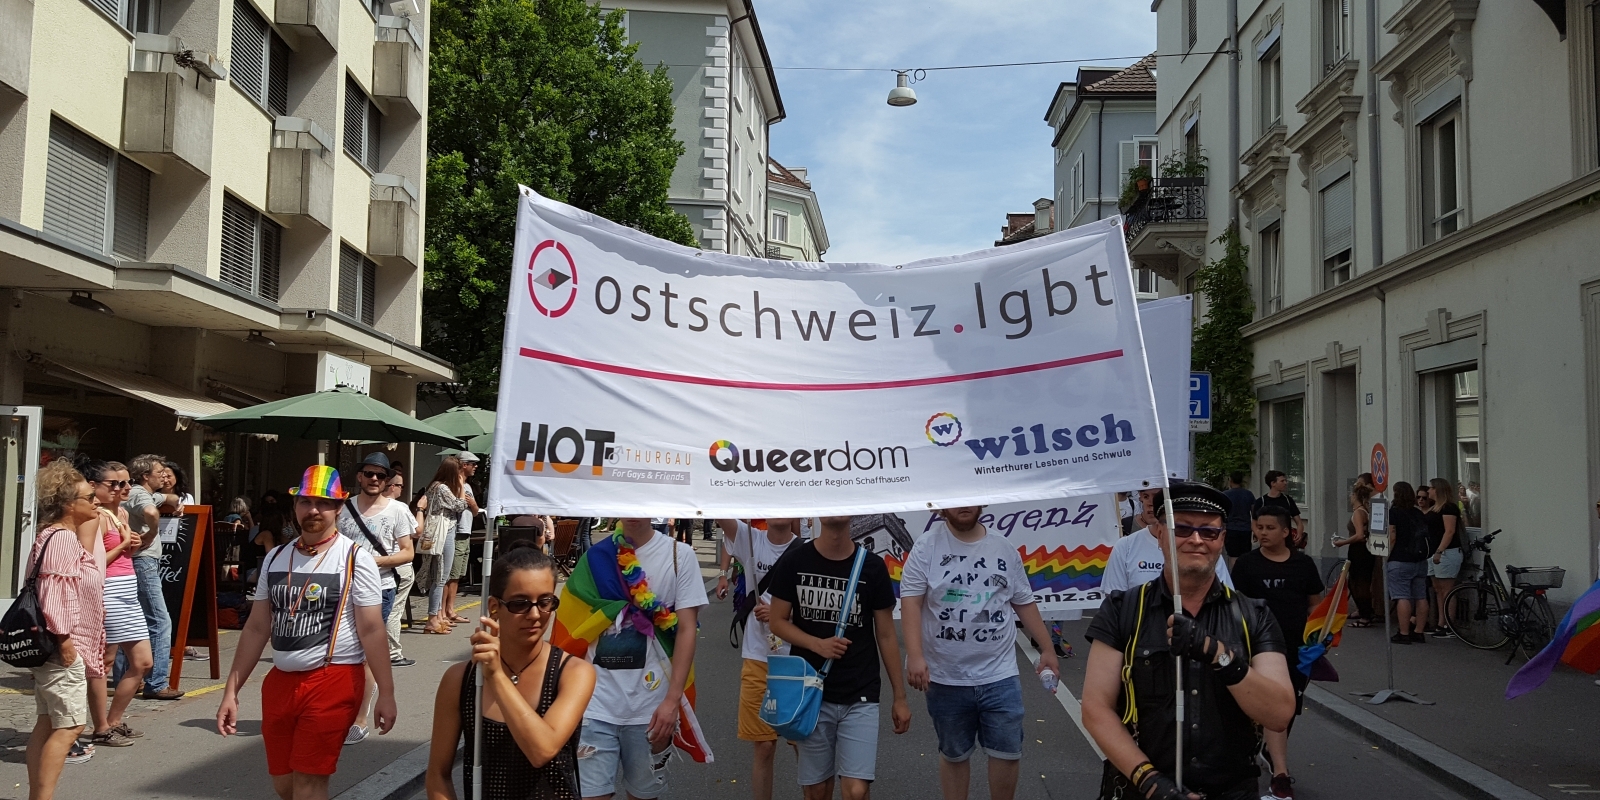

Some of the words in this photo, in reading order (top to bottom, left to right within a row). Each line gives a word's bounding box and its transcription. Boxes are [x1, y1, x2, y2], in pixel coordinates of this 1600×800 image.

[594, 264, 1114, 342] ostschweiz.lgbt
[514, 421, 616, 476] HOT
[964, 413, 1137, 461] wilsch
[626, 448, 692, 466] THURGAU
[708, 439, 910, 474] Queerdom
[974, 461, 1033, 475] Winterthurer
[1035, 457, 1069, 469] Lesben
[1072, 453, 1090, 464] und
[1092, 448, 1132, 461] Schwule
[611, 468, 626, 478] For
[627, 469, 646, 480] Gays
[646, 471, 653, 479] &
[654, 471, 686, 482] Friends
[710, 478, 776, 487] Les-bi-schwuler
[778, 478, 807, 487] Verein
[808, 477, 822, 486] der
[825, 477, 854, 487] Region
[856, 475, 911, 485] Schaffhausen
[923, 500, 1099, 538] egenz
[801, 588, 862, 613] ADVISO
[10, 638, 33, 651] WAR
